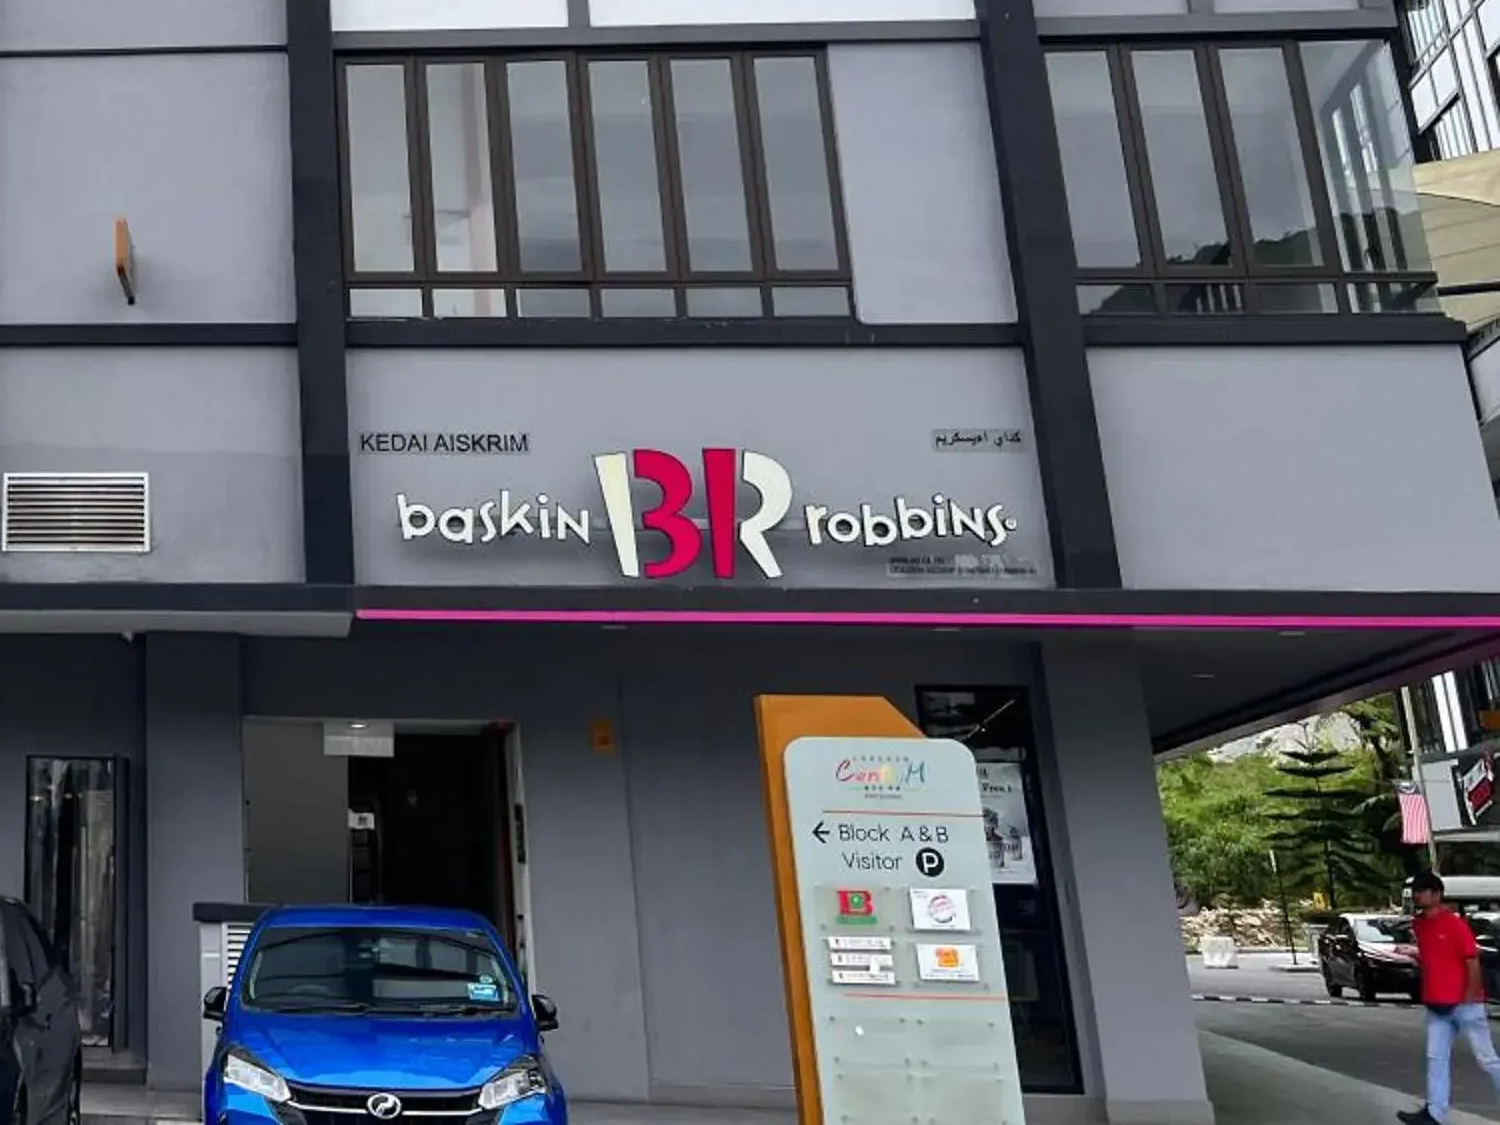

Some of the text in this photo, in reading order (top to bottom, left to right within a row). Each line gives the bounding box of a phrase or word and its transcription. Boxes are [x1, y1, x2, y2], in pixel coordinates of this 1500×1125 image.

[360, 433, 530, 452] KEDAI AISKRIM
[397, 490, 591, 546] baskin
[804, 493, 1002, 550] robbins
[838, 823, 890, 842] Block
[841, 851, 903, 870] Visitor
